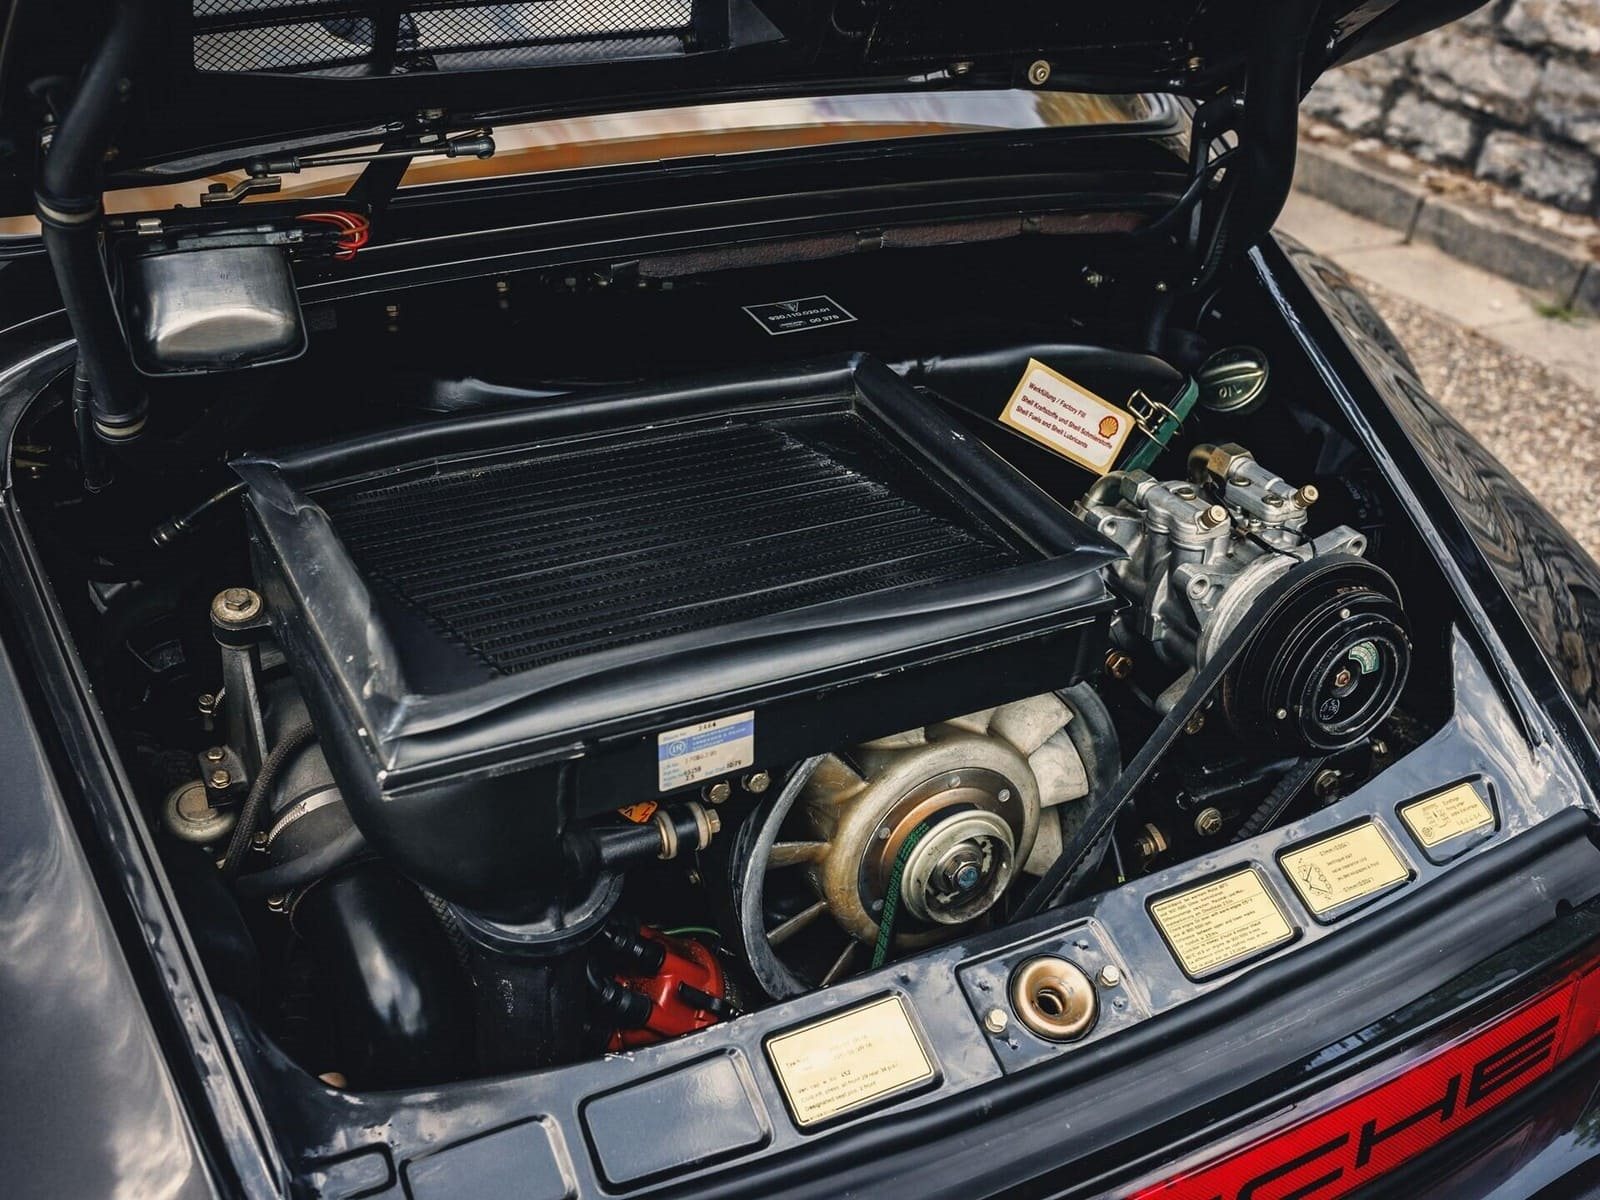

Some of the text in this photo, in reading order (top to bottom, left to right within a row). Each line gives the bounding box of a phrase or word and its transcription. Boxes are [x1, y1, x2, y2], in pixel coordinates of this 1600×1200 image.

[1029, 382, 1057, 403] Werkfüllung
[1059, 400, 1078, 415] Factory
[1077, 410, 1087, 418] Fill
[1219, 384, 1242, 398] OIL
[1016, 405, 1088, 448] Shell Fuels and Shell Lubricants
[1021, 395, 1113, 449] Shell Kraftstoffe und Shell Schmierstoffe
[1211, 1015, 1560, 1200] CHE
